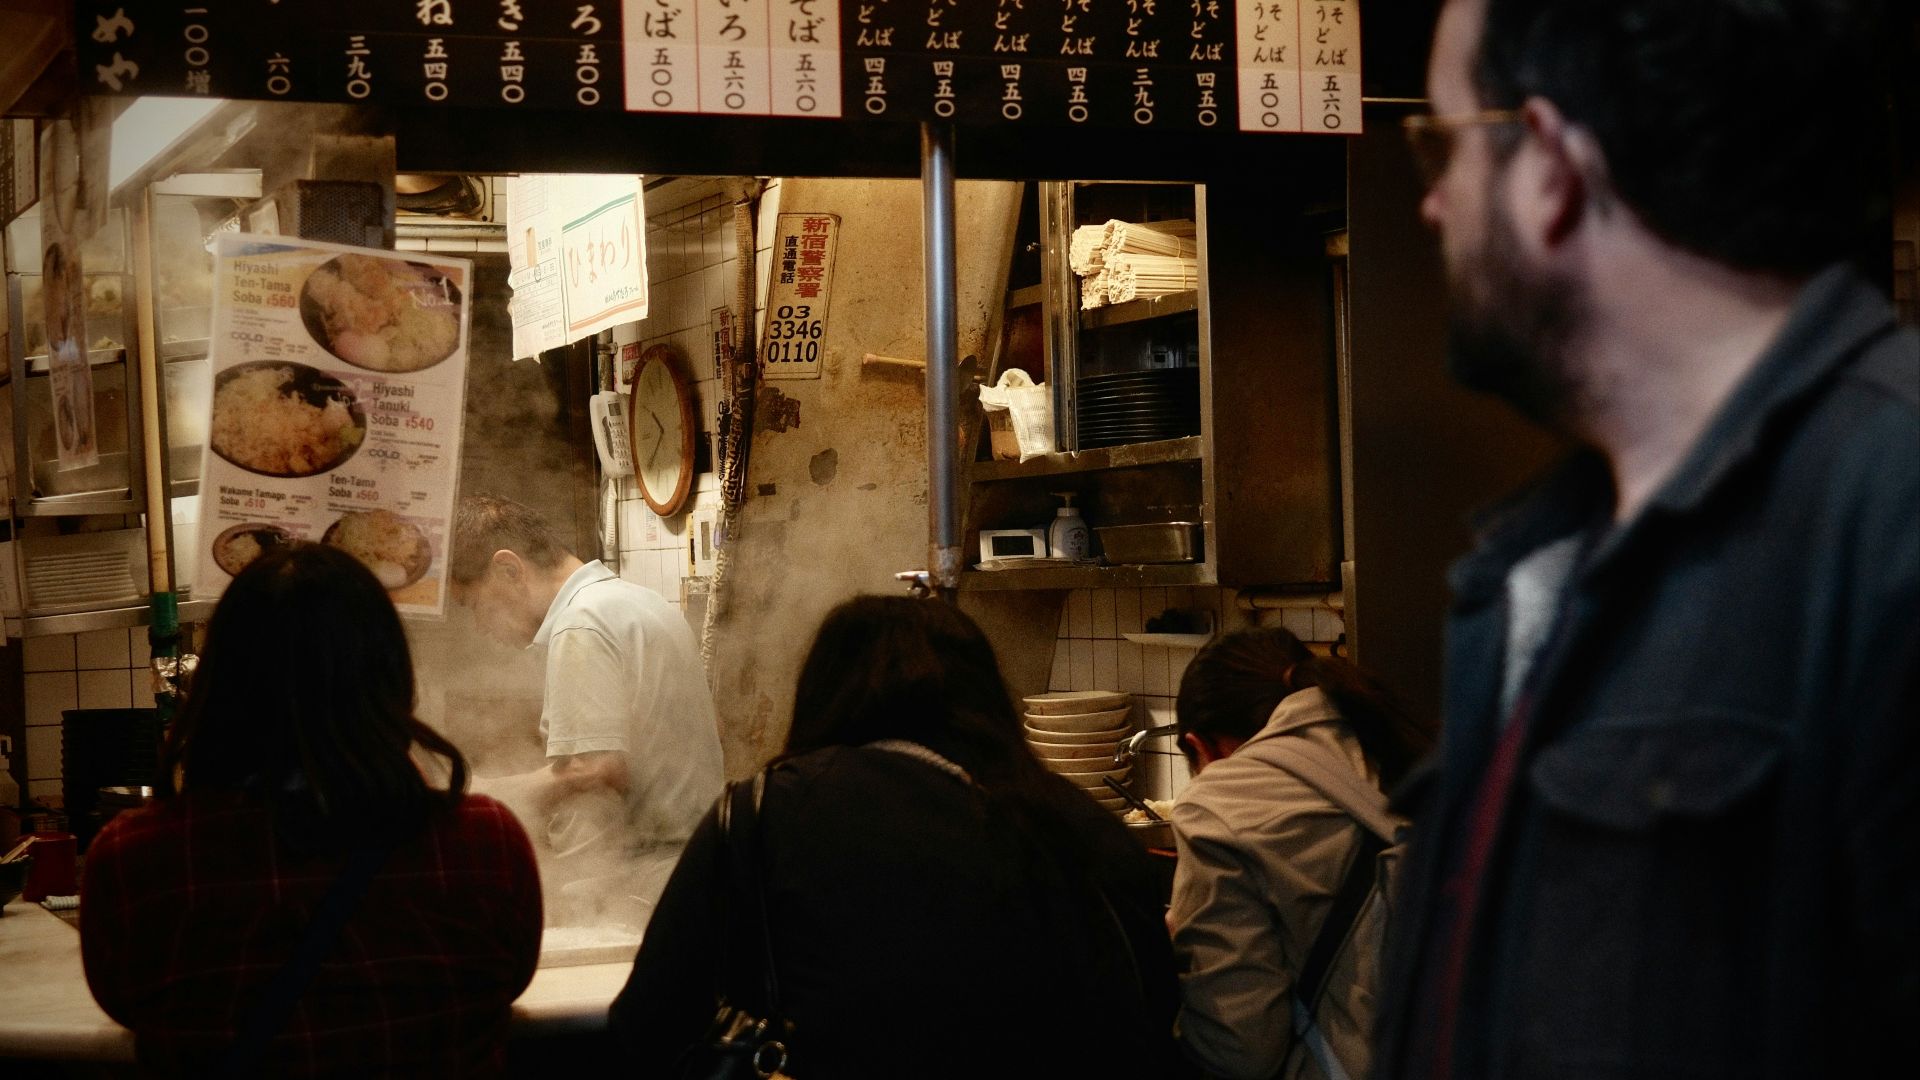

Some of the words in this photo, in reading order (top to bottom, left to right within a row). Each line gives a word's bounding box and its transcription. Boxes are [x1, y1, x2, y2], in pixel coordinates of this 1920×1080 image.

[1252, 2, 1269, 64] うどん
[1269, 3, 1287, 64] そば
[1315, 5, 1332, 66] うどん
[1330, 6, 1348, 66] そば
[345, 35, 373, 99] 三九〇
[423, 38, 450, 102] 五四〇
[500, 40, 526, 104] 五四〇
[575, 43, 601, 107] 五〇〇
[650, 47, 674, 109] 五〇〇
[723, 50, 746, 111] 五六〇
[795, 53, 817, 113] 五六〇
[863, 57, 887, 115] 四五〇
[932, 60, 955, 118] 四五〇
[1000, 63, 1023, 120] 四五〇
[1066, 67, 1089, 123] 四五〇
[1132, 67, 1155, 125] 三九〇
[1196, 72, 1218, 127] 四五〇
[1260, 73, 1281, 129] 五〇〇
[1321, 75, 1342, 130] 五六〇
[233, 259, 279, 275] Hiyashi
[568, 216, 630, 289] ひまわり
[780, 235, 799, 285] 直通電話
[794, 216, 831, 299] 新宿警察署
[233, 275, 292, 293] Ten-Tama
[233, 290, 263, 304] Soba
[777, 305, 811, 319] 03
[767, 341, 818, 363] 0110
[769, 320, 822, 340] 3346
[372, 397, 410, 413] Tanuki
[373, 382, 415, 398] Hiyashi
[370, 413, 400, 427] Soba
[328, 486, 353, 499] Soba
[329, 474, 377, 488] Ten-Tama
